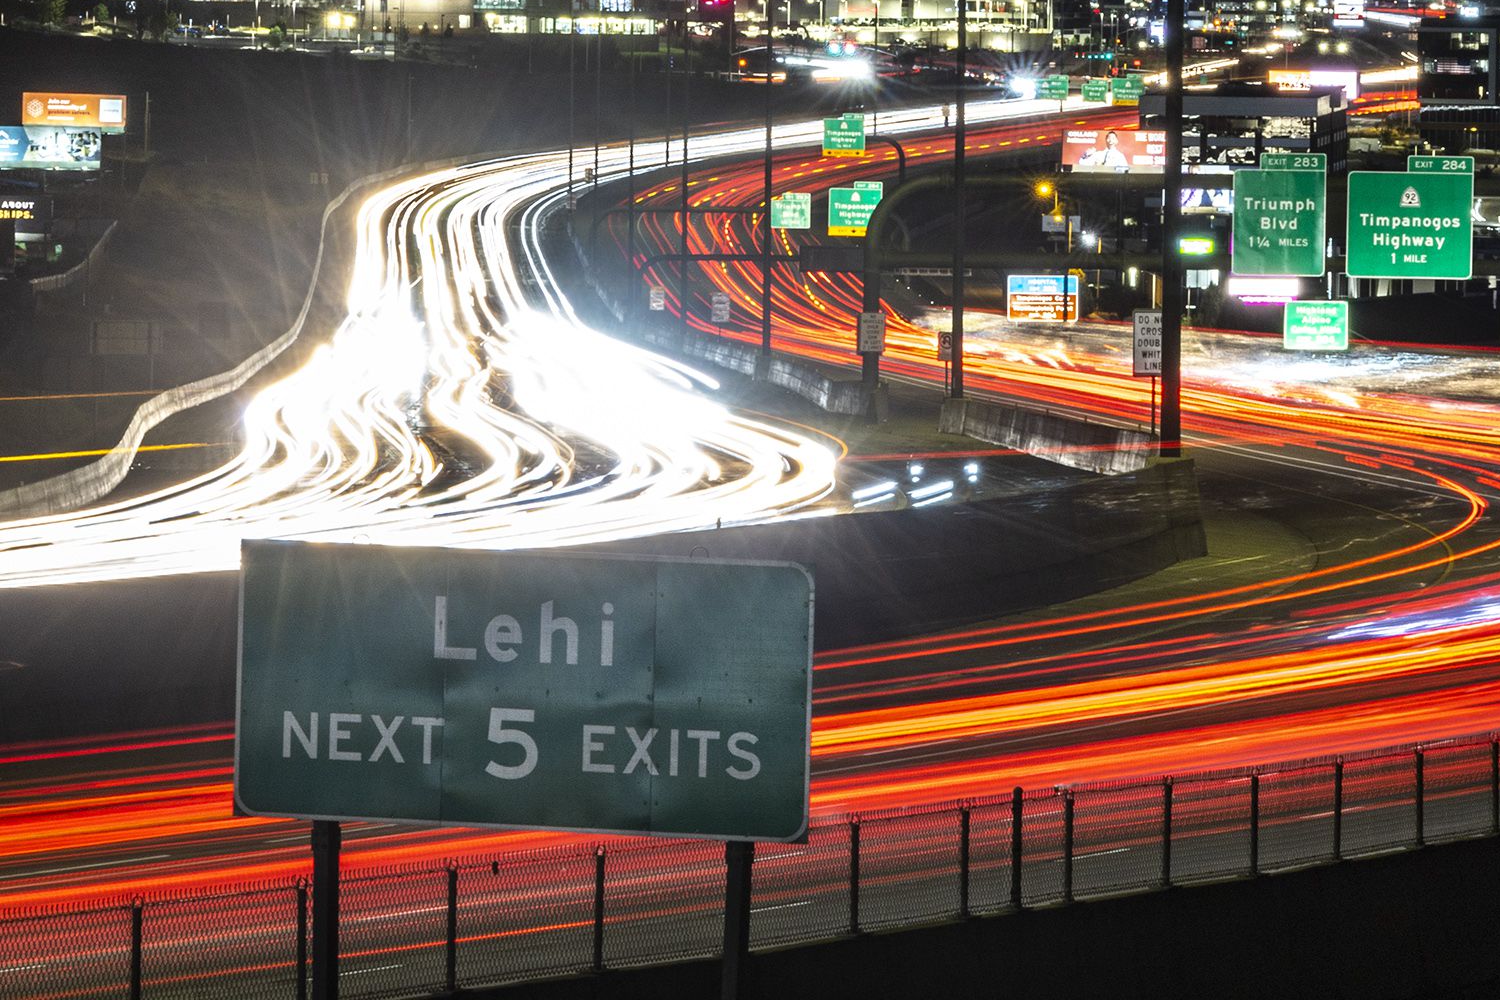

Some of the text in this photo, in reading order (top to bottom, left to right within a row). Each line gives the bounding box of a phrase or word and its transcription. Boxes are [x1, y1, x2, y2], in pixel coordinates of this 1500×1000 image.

[1268, 157, 1318, 167] EXIT 283
[1442, 160, 1466, 170] 284
[1405, 193, 1416, 201] 92
[2, 201, 35, 209] ABOUT
[1244, 197, 1315, 213] Triumph
[1260, 217, 1298, 230] Blvd
[1360, 213, 1461, 231] Timpanogos
[1279, 238, 1308, 247] MILES
[1373, 233, 1445, 250] Highway
[1391, 253, 1428, 264] 1 MILE
[1138, 315, 1150, 324] DO
[1141, 327, 1162, 336] CROS
[1138, 339, 1160, 347] DOUB
[1142, 350, 1161, 358] WHIT
[433, 595, 615, 667] Lehi
[282, 708, 761, 780] NEXT 5 EXITS
